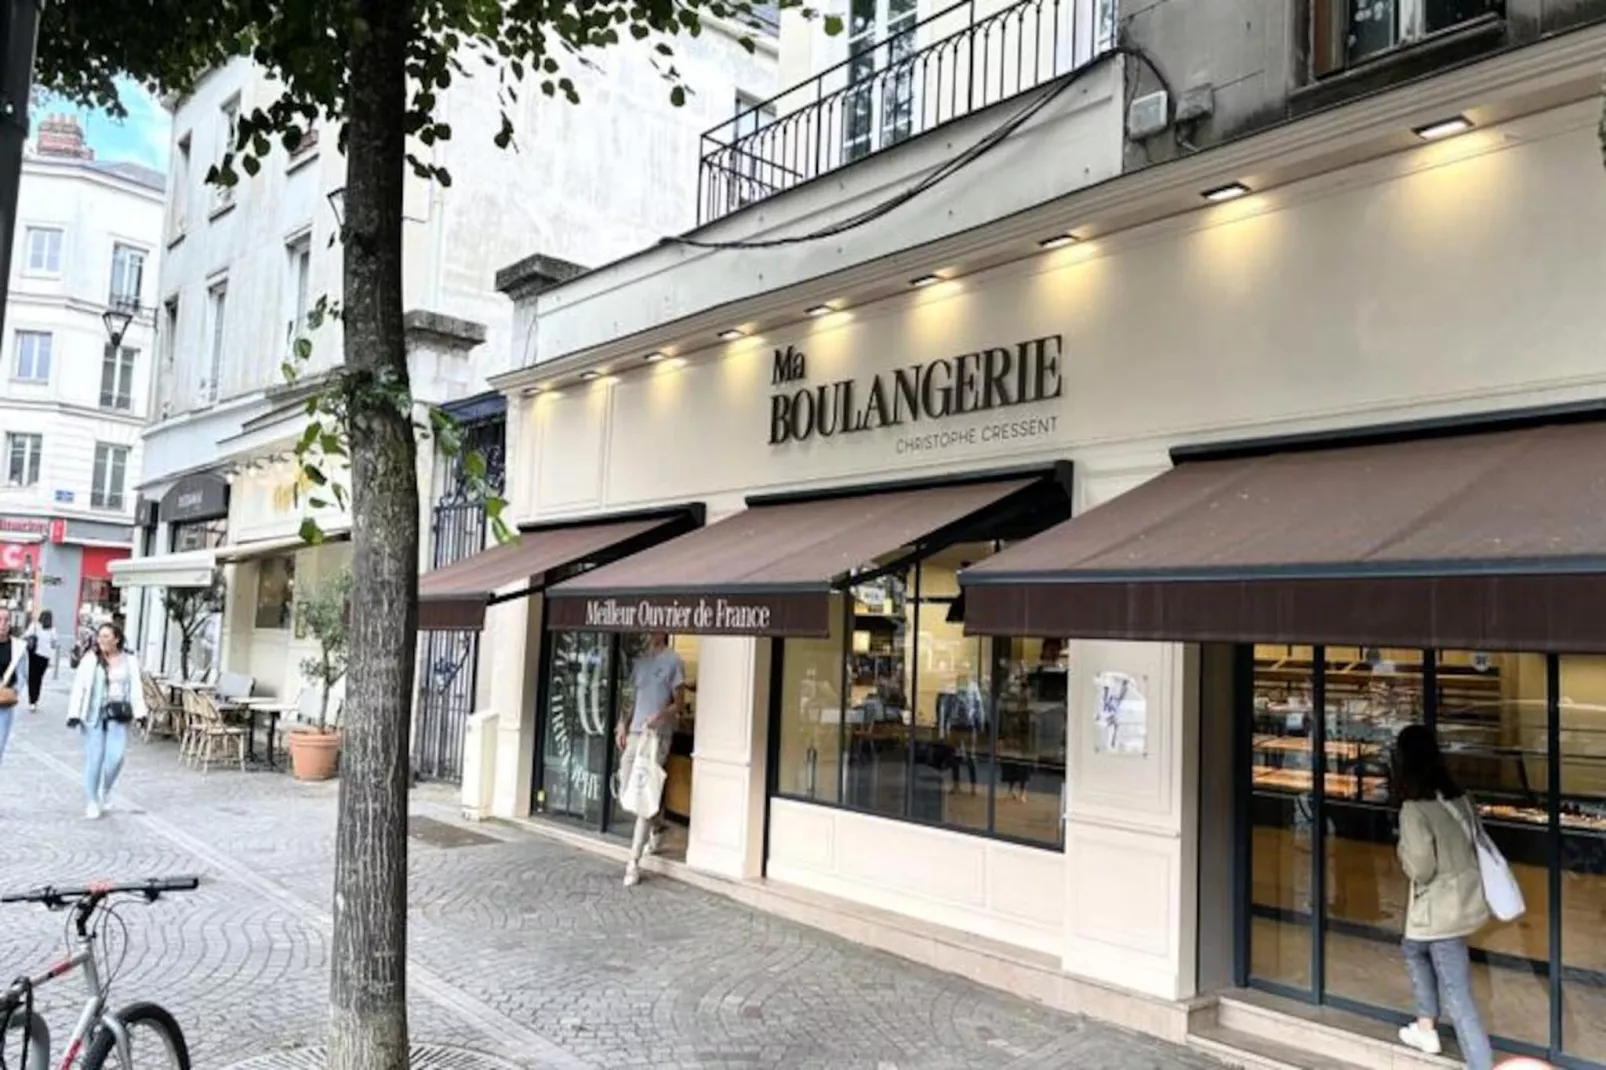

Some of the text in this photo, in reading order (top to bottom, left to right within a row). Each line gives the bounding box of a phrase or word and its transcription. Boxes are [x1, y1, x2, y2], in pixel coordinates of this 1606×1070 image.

[772, 345, 805, 385] Ma
[769, 335, 1062, 445] BOULANGERIE
[896, 416, 1057, 455] CHRISTOPHE CRESSENT
[585, 599, 770, 628] Meilleur Ouvrier de France
